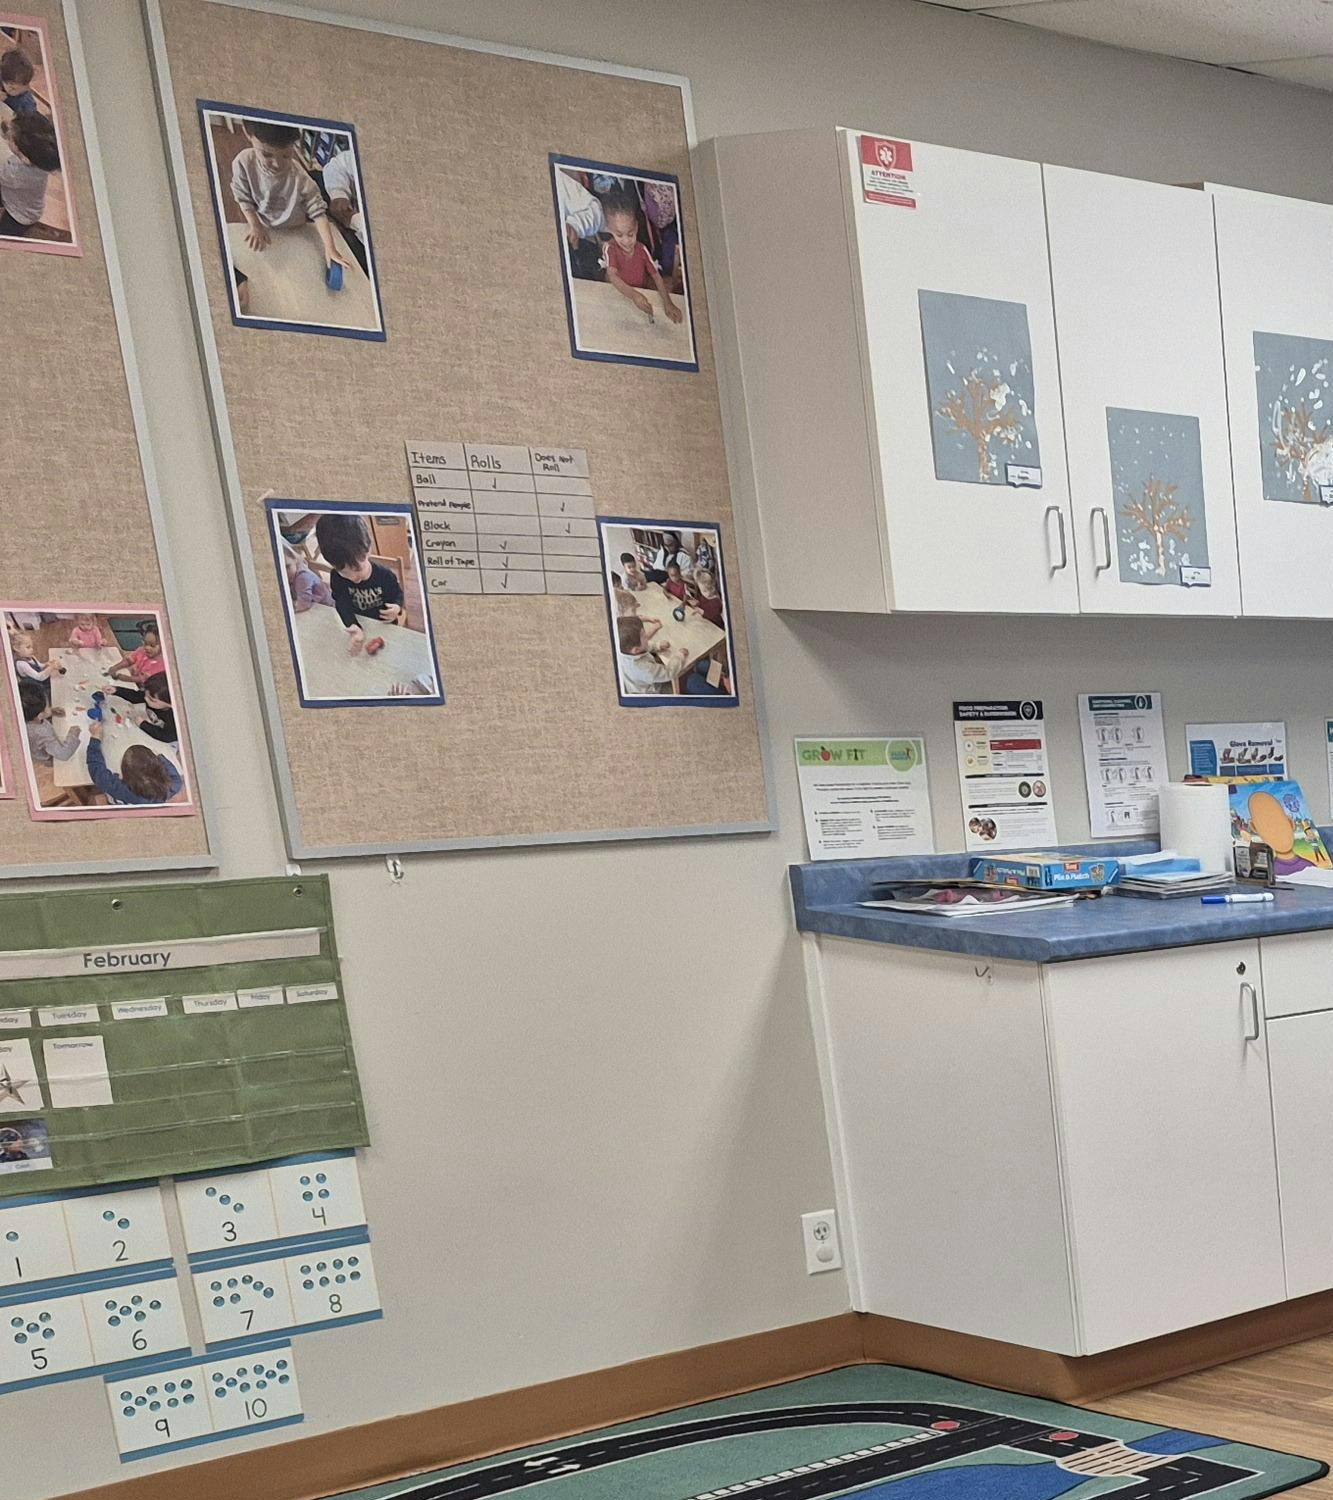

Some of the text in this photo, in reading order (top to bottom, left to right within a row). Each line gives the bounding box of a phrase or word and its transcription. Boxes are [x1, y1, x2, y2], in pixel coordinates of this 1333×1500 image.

[410, 452, 446, 465] Items
[470, 455, 501, 469] Rolls
[416, 474, 437, 484] Ball
[423, 521, 451, 531] Block
[426, 539, 456, 550] Crayon
[427, 557, 443, 566] Roll
[457, 558, 475, 566] Tape
[431, 579, 447, 588] Car
[83, 951, 171, 969] February
[52, 1012, 87, 1020] Tuesday
[193, 998, 228, 1008] Thursday
[297, 987, 328, 997] Saturday
[15, 1206, 327, 1277] 1 2 3 4
[31, 1294, 343, 1370] 5 6 7 8
[155, 1398, 268, 1437] 9 10
